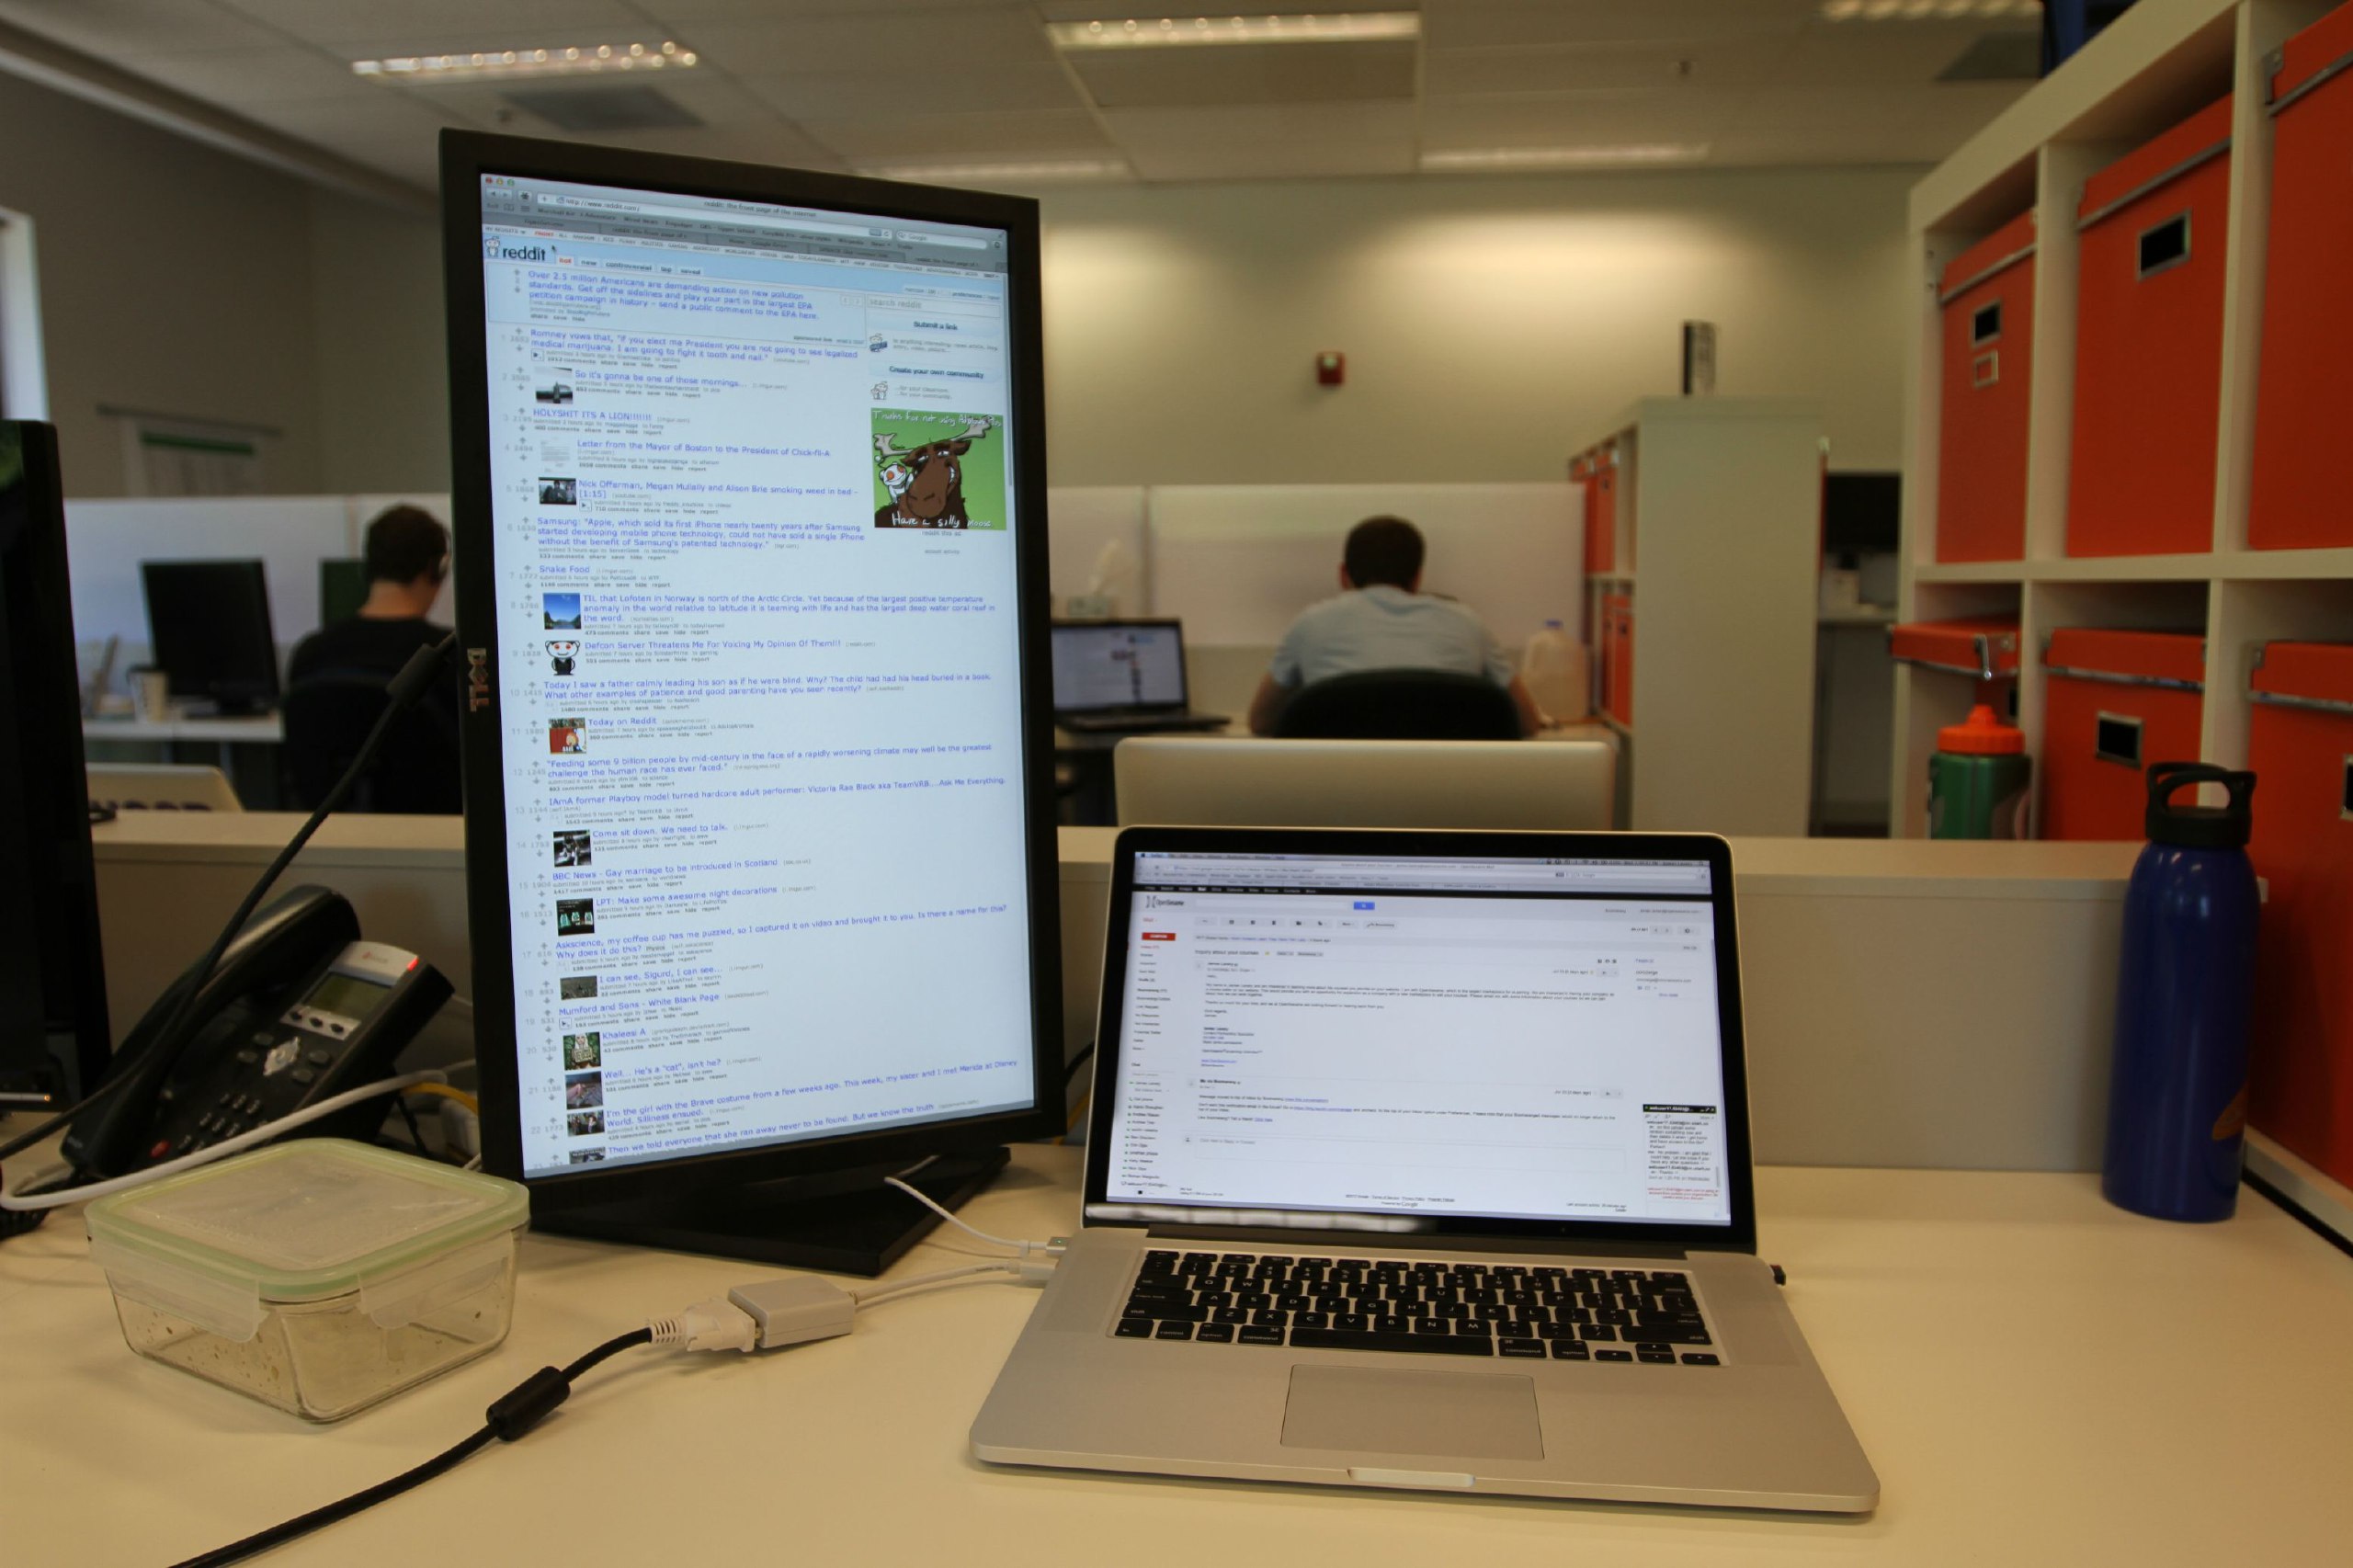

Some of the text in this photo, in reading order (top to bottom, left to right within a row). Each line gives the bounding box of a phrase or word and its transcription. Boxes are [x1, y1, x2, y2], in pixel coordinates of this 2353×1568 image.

[605, 261, 653, 271] controversial
[528, 269, 550, 278] Over
[552, 271, 567, 280] 2.5
[570, 273, 597, 282] million
[599, 275, 645, 286] Americans
[664, 280, 710, 293] demanding
[711, 285, 737, 294] action
[770, 290, 803, 300] pollution
[577, 283, 593, 292] Get
[595, 285, 608, 293] off
[609, 286, 624, 294] the
[626, 288, 663, 298] sidelines
[682, 292, 700, 302] play
[702, 295, 722, 303] your
[722, 296, 741, 304] part
[742, 296, 750, 304] in
[752, 297, 766, 305] the
[767, 299, 795, 309] largest
[797, 301, 813, 310] EPA
[869, 299, 922, 309] search reddit
[913, 321, 938, 330] Submit
[945, 323, 959, 331] link
[574, 369, 586, 378] So
[588, 370, 601, 379] it's
[603, 372, 631, 381] gonna
[632, 372, 643, 381] be
[675, 375, 699, 384] those
[889, 366, 913, 374] Create
[913, 368, 929, 376] your
[946, 369, 984, 380] community
[576, 438, 602, 447] Letter
[605, 439, 626, 448] from
[628, 440, 642, 449] the
[645, 441, 670, 451] Mayor
[684, 443, 712, 451] Boston
[714, 444, 723, 452] to
[741, 446, 779, 454] President
[578, 479, 597, 487] Nick
[645, 481, 674, 491] Megan
[725, 483, 749, 492] Alison
[769, 485, 802, 494] smoking
[892, 510, 918, 526] Have
[938, 515, 961, 528] silly
[539, 564, 590, 573] Snake Food
[584, 641, 614, 649] Defcon
[691, 640, 704, 648] Me
[753, 640, 764, 649] My
[767, 640, 796, 649] Opinion
[467, 647, 489, 712] DELL
[588, 718, 614, 727] Today
[630, 716, 656, 724] Reddit
[547, 768, 588, 778] challenge
[590, 767, 605, 776] the
[660, 765, 676, 773] has
[592, 829, 618, 837] Come
[620, 827, 631, 835] sit
[660, 825, 675, 834] We
[676, 824, 698, 833] need
[551, 871, 571, 881] BBC
[573, 870, 597, 879] News
[605, 869, 622, 878] Gay
[624, 866, 663, 875] marriage
[689, 860, 732, 870] introduced
[744, 858, 778, 867] Scotland
[617, 895, 640, 904] Make
[642, 894, 665, 903] some
[667, 892, 706, 901] awesome
[709, 888, 729, 898] night
[731, 886, 777, 895] decorations
[558, 1004, 597, 1016] Mumford
[599, 1002, 616, 1011] and
[647, 997, 672, 1006] White
[674, 994, 697, 1004] Blank
[699, 994, 720, 1002] Page
[633, 1066, 652, 1075] He's
[687, 1060, 704, 1069] isn't
[706, 1058, 722, 1067] he?
